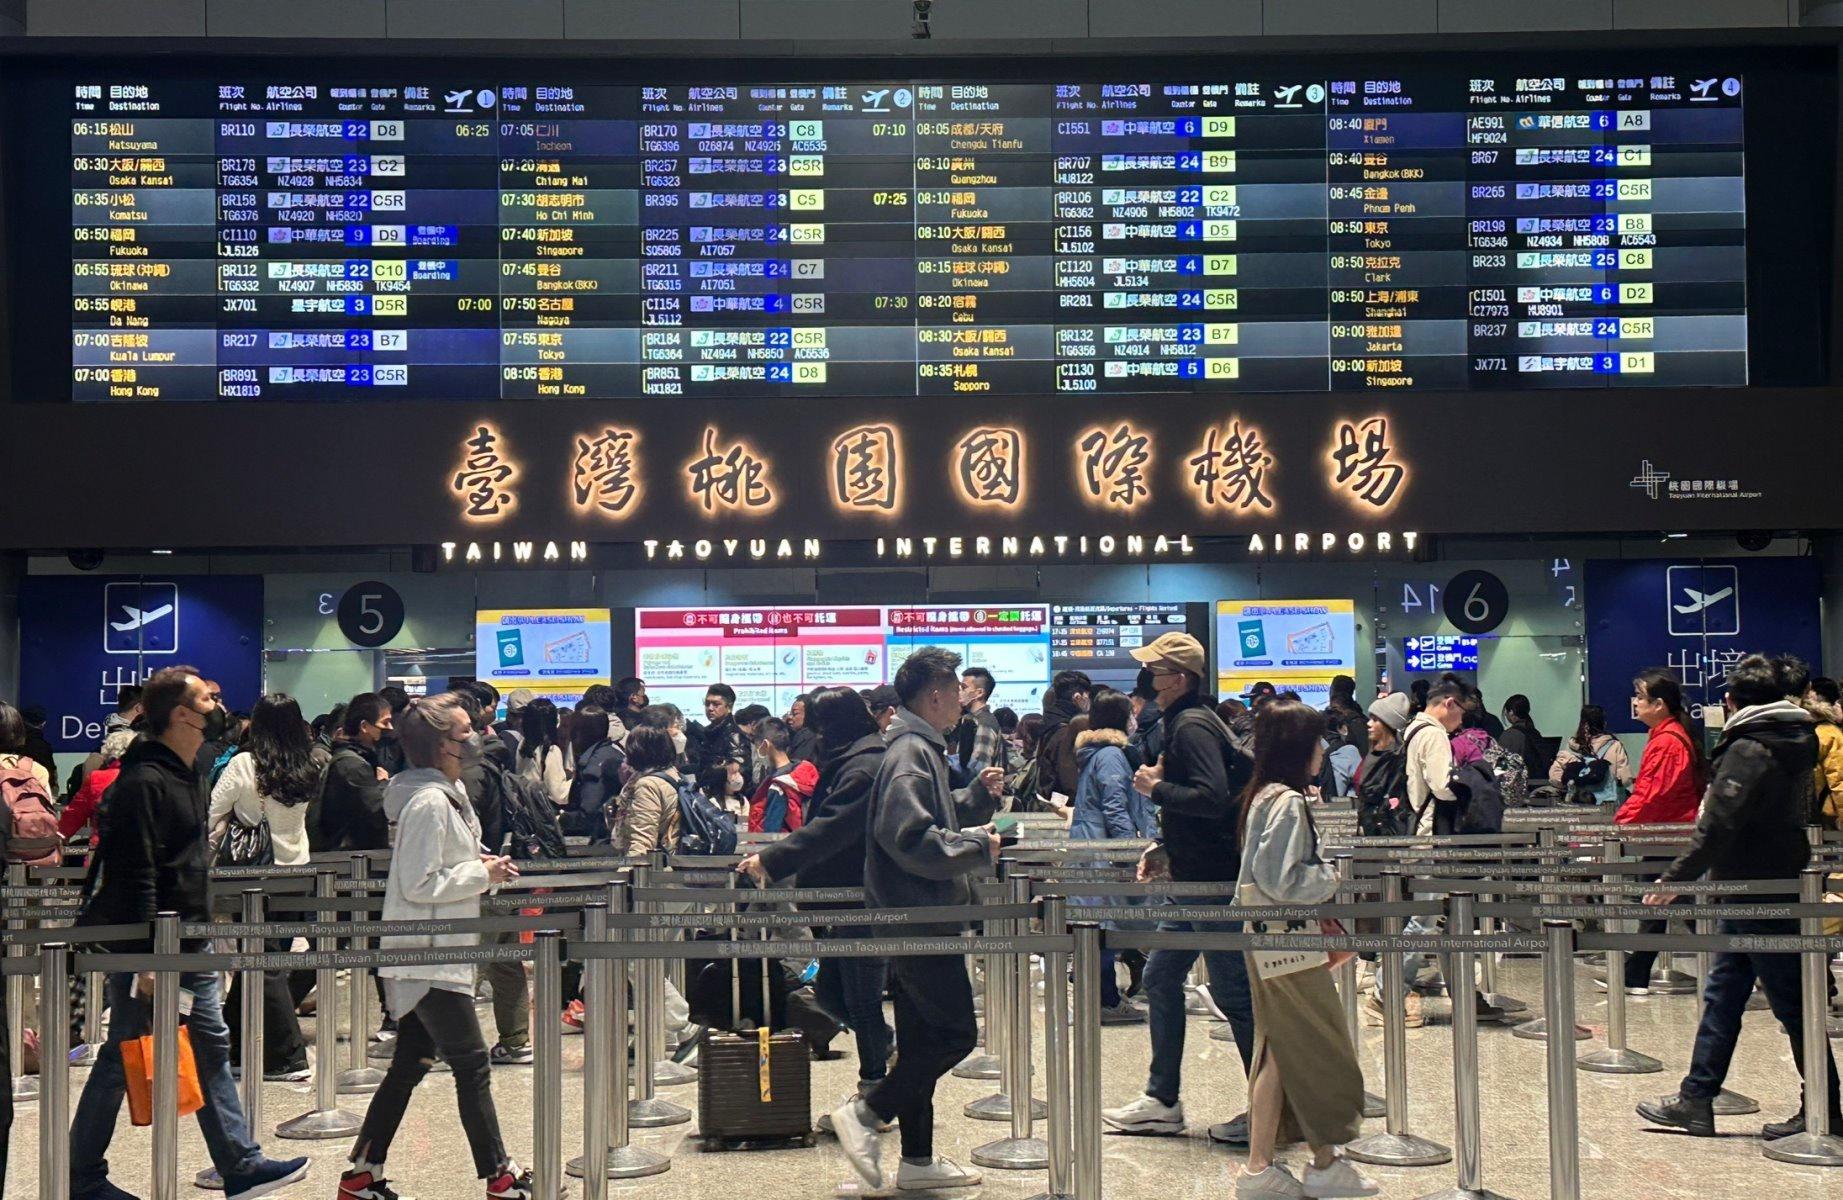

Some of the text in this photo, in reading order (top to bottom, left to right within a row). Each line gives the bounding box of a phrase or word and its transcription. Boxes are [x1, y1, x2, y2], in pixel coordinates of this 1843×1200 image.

[76, 86, 148, 99] 時間 目的地
[74, 123, 397, 136] 06:15 松山 BR110 D8
[917, 121, 1228, 136] 08:05 成都/天府 CI551 D9
[918, 191, 1228, 205] 08:10 福岡 BR106 C2
[1330, 184, 1649, 199] 08:45 BR265 C5R
[74, 194, 403, 206] 06:35 小松 BR158 C5R
[502, 194, 816, 206] 07:30 胡志明市 BR395 C5
[110, 210, 147, 220] Komatsu
[536, 211, 547, 220] Ho
[1330, 219, 1644, 234] 08:50 東京 BR198 B8
[502, 228, 822, 241] 07:40 新加坡 BR225 C5R
[1365, 239, 1391, 249] Tokyo
[918, 260, 1229, 274] 08:15 CI120 D7
[1331, 254, 1645, 269] 08:50 克拉克 BR233 C8
[75, 264, 108, 276] 06:55
[222, 265, 257, 277] BR112
[375, 265, 403, 276] C10
[1365, 273, 1391, 282] Clark
[223, 281, 259, 291] TG6332
[75, 334, 399, 347] 07:00 吉隆坡 BR217 B7
[503, 333, 537, 345] 07:55
[647, 333, 680, 345] BR184
[794, 333, 823, 344] C5R
[538, 350, 565, 360] Tokyo
[920, 364, 952, 377] 08:35
[1061, 364, 1094, 376] CI130
[1212, 363, 1230, 374] D6
[1332, 360, 1365, 372] 09:00
[1475, 359, 1507, 371] JX771
[1628, 357, 1645, 368] D1
[442, 532, 1418, 560] TAIWAN TAOYUAN INTERNATIONAL AIRPORT
[1464, 582, 1489, 621] 6
[359, 594, 384, 634] 5
[903, 941, 971, 951] International
[974, 940, 1012, 950] Airport
[1514, 937, 1547, 950] Airpo
[497, 949, 534, 960] Airpor
